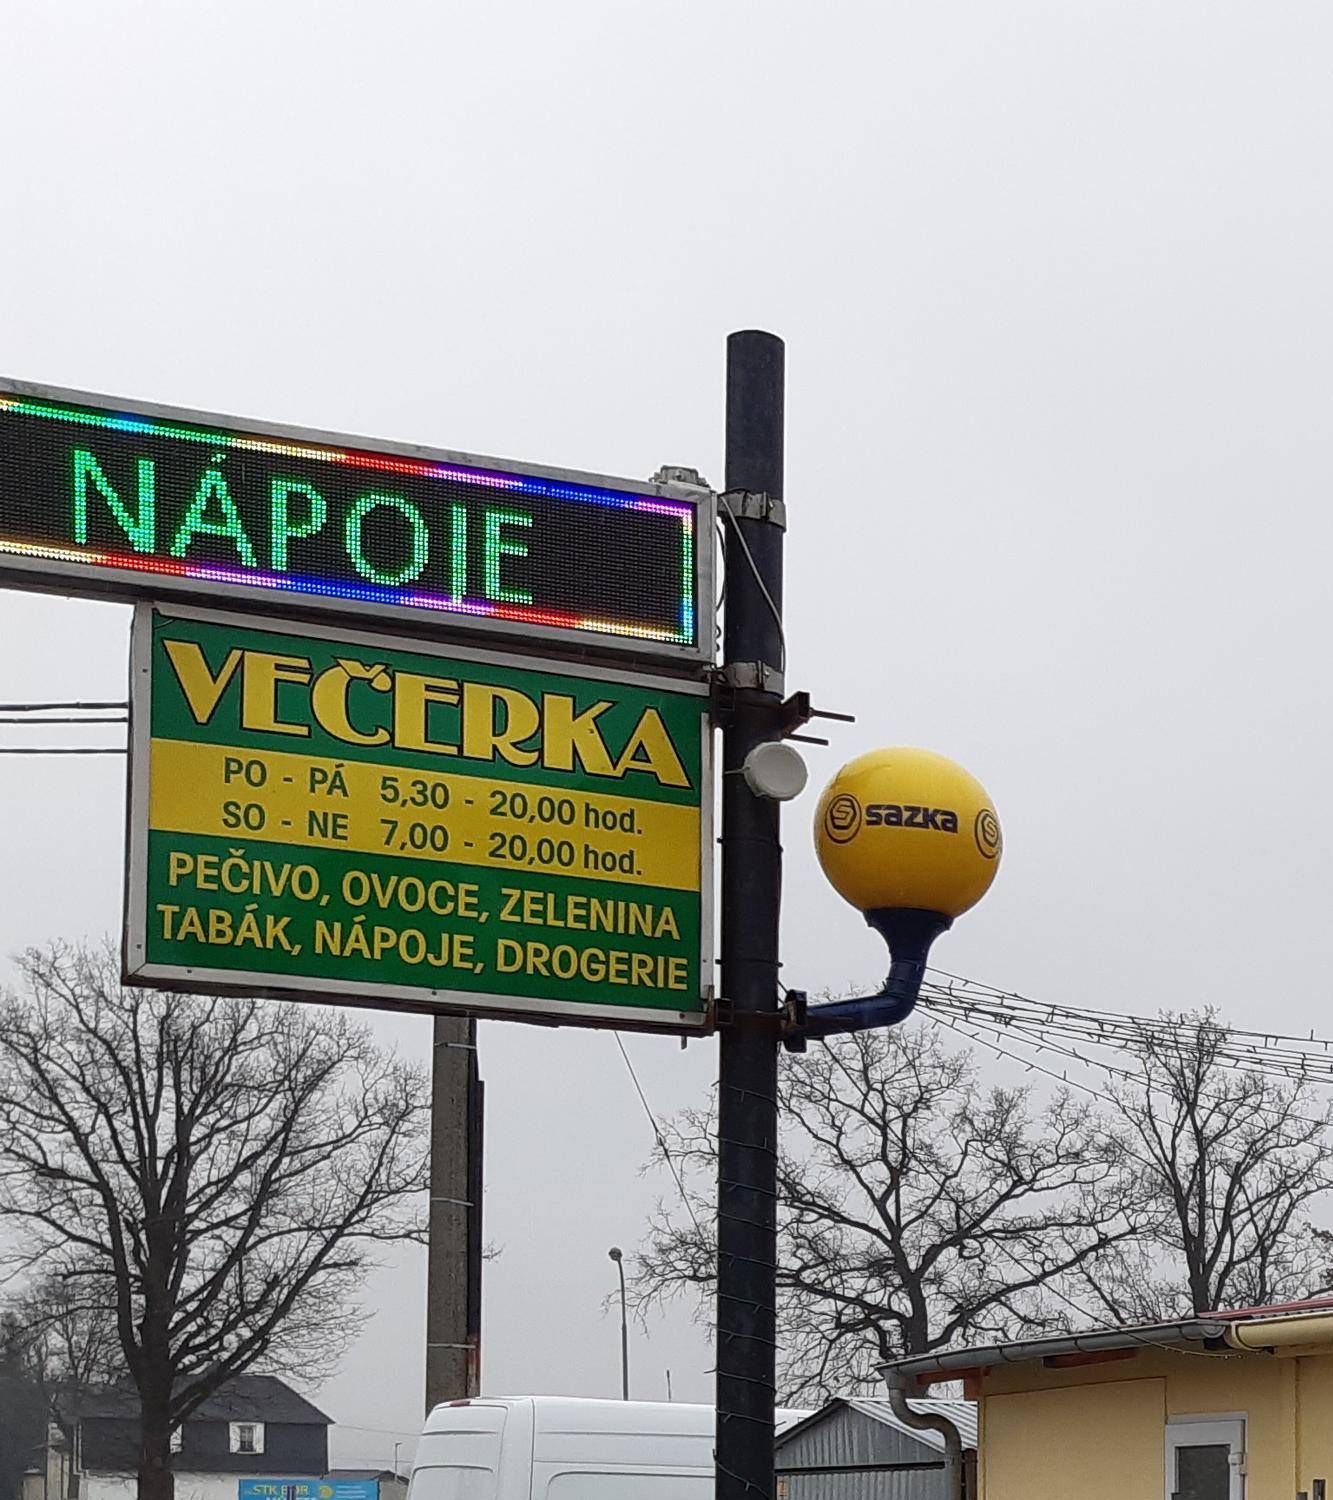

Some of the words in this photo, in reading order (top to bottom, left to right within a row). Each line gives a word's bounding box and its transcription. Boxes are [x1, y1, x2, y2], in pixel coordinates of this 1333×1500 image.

[161, 638, 695, 790] VEČERKA
[222, 801, 266, 831] SO
[308, 810, 348, 841] NE
[380, 818, 449, 852] 7,00
[488, 831, 575, 867] 20,00
[583, 843, 642, 875] hod.
[224, 756, 267, 787] PO
[309, 763, 349, 798] PÁ
[380, 775, 450, 810] 5,30
[489, 789, 575, 825] 20,00
[584, 802, 642, 834] hod.
[168, 847, 330, 907] PEČIVO,
[342, 870, 490, 924] OVOCE,
[500, 887, 681, 941] ZELENINA
[156, 903, 302, 956] TABÁK,
[315, 914, 485, 975] NÁPOJE,
[496, 938, 689, 991] DROGERIE
